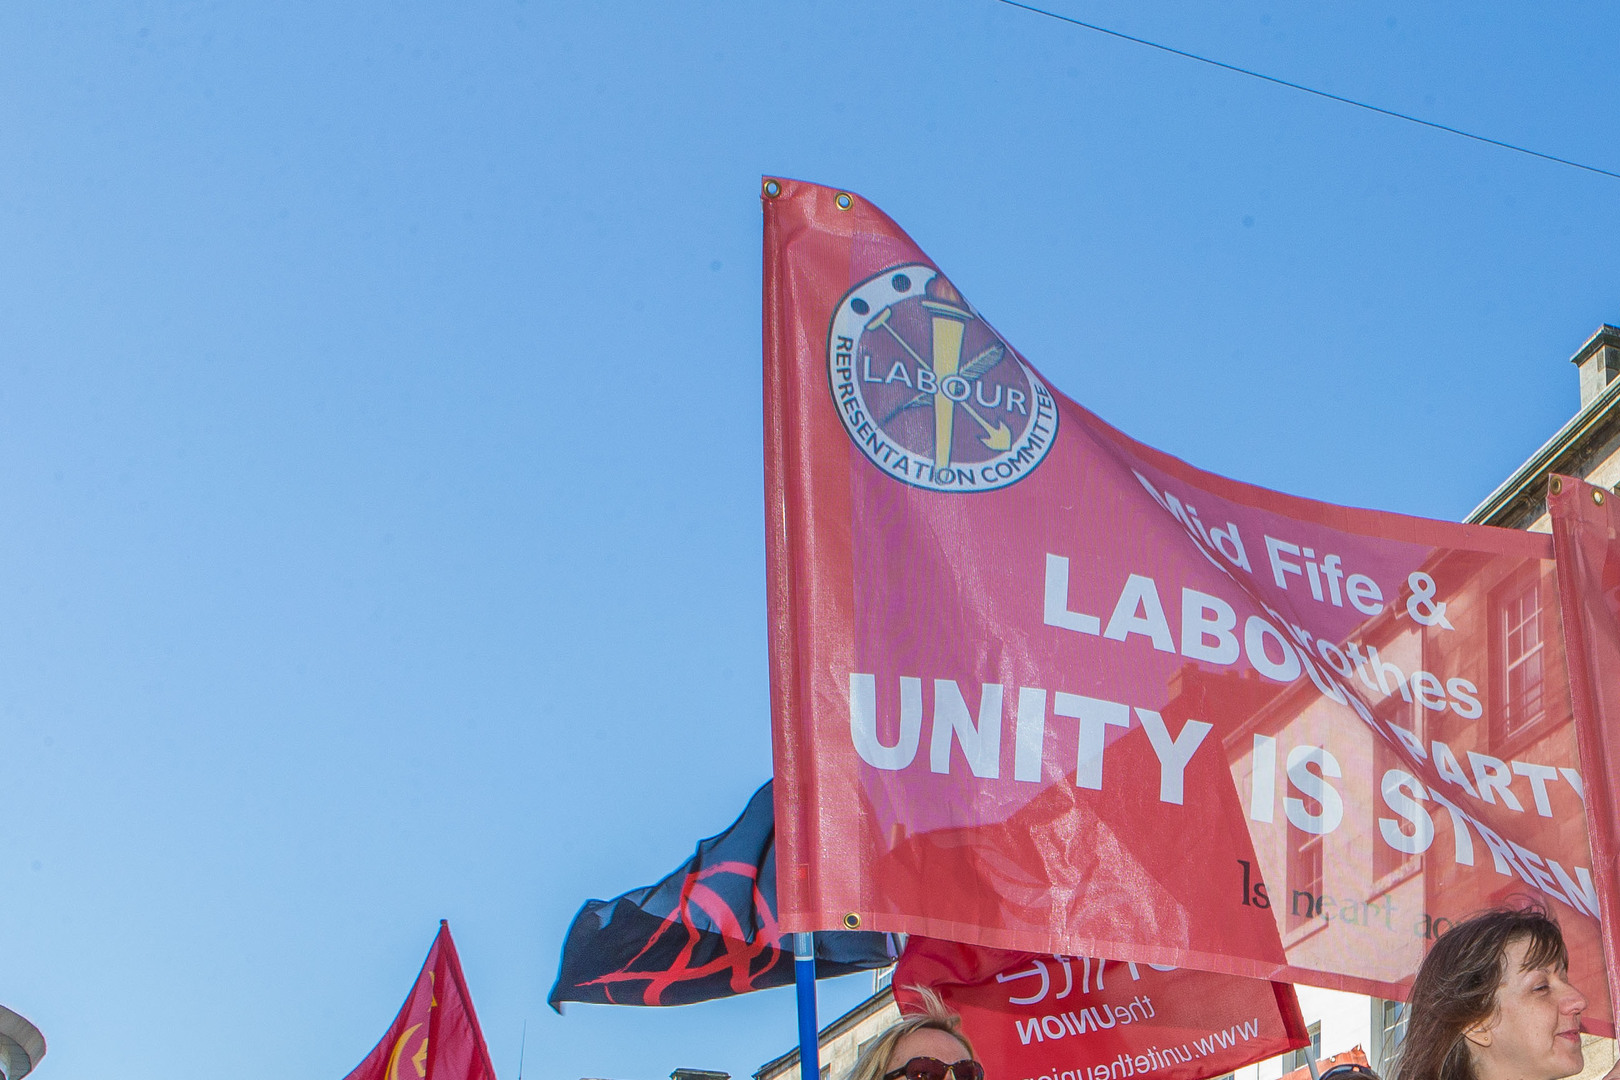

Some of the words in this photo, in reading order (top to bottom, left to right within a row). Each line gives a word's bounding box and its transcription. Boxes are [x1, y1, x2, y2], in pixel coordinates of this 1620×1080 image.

[835, 335, 976, 486] REPRESENTATION
[980, 384, 1054, 483] COMMITTEE
[863, 356, 1027, 415] LABOUR
[1264, 534, 1384, 616] Fife
[1406, 571, 1455, 631] &
[849, 672, 1214, 805] UNITY
[1250, 733, 1344, 835] IS
[1378, 768, 1601, 922] STREN
